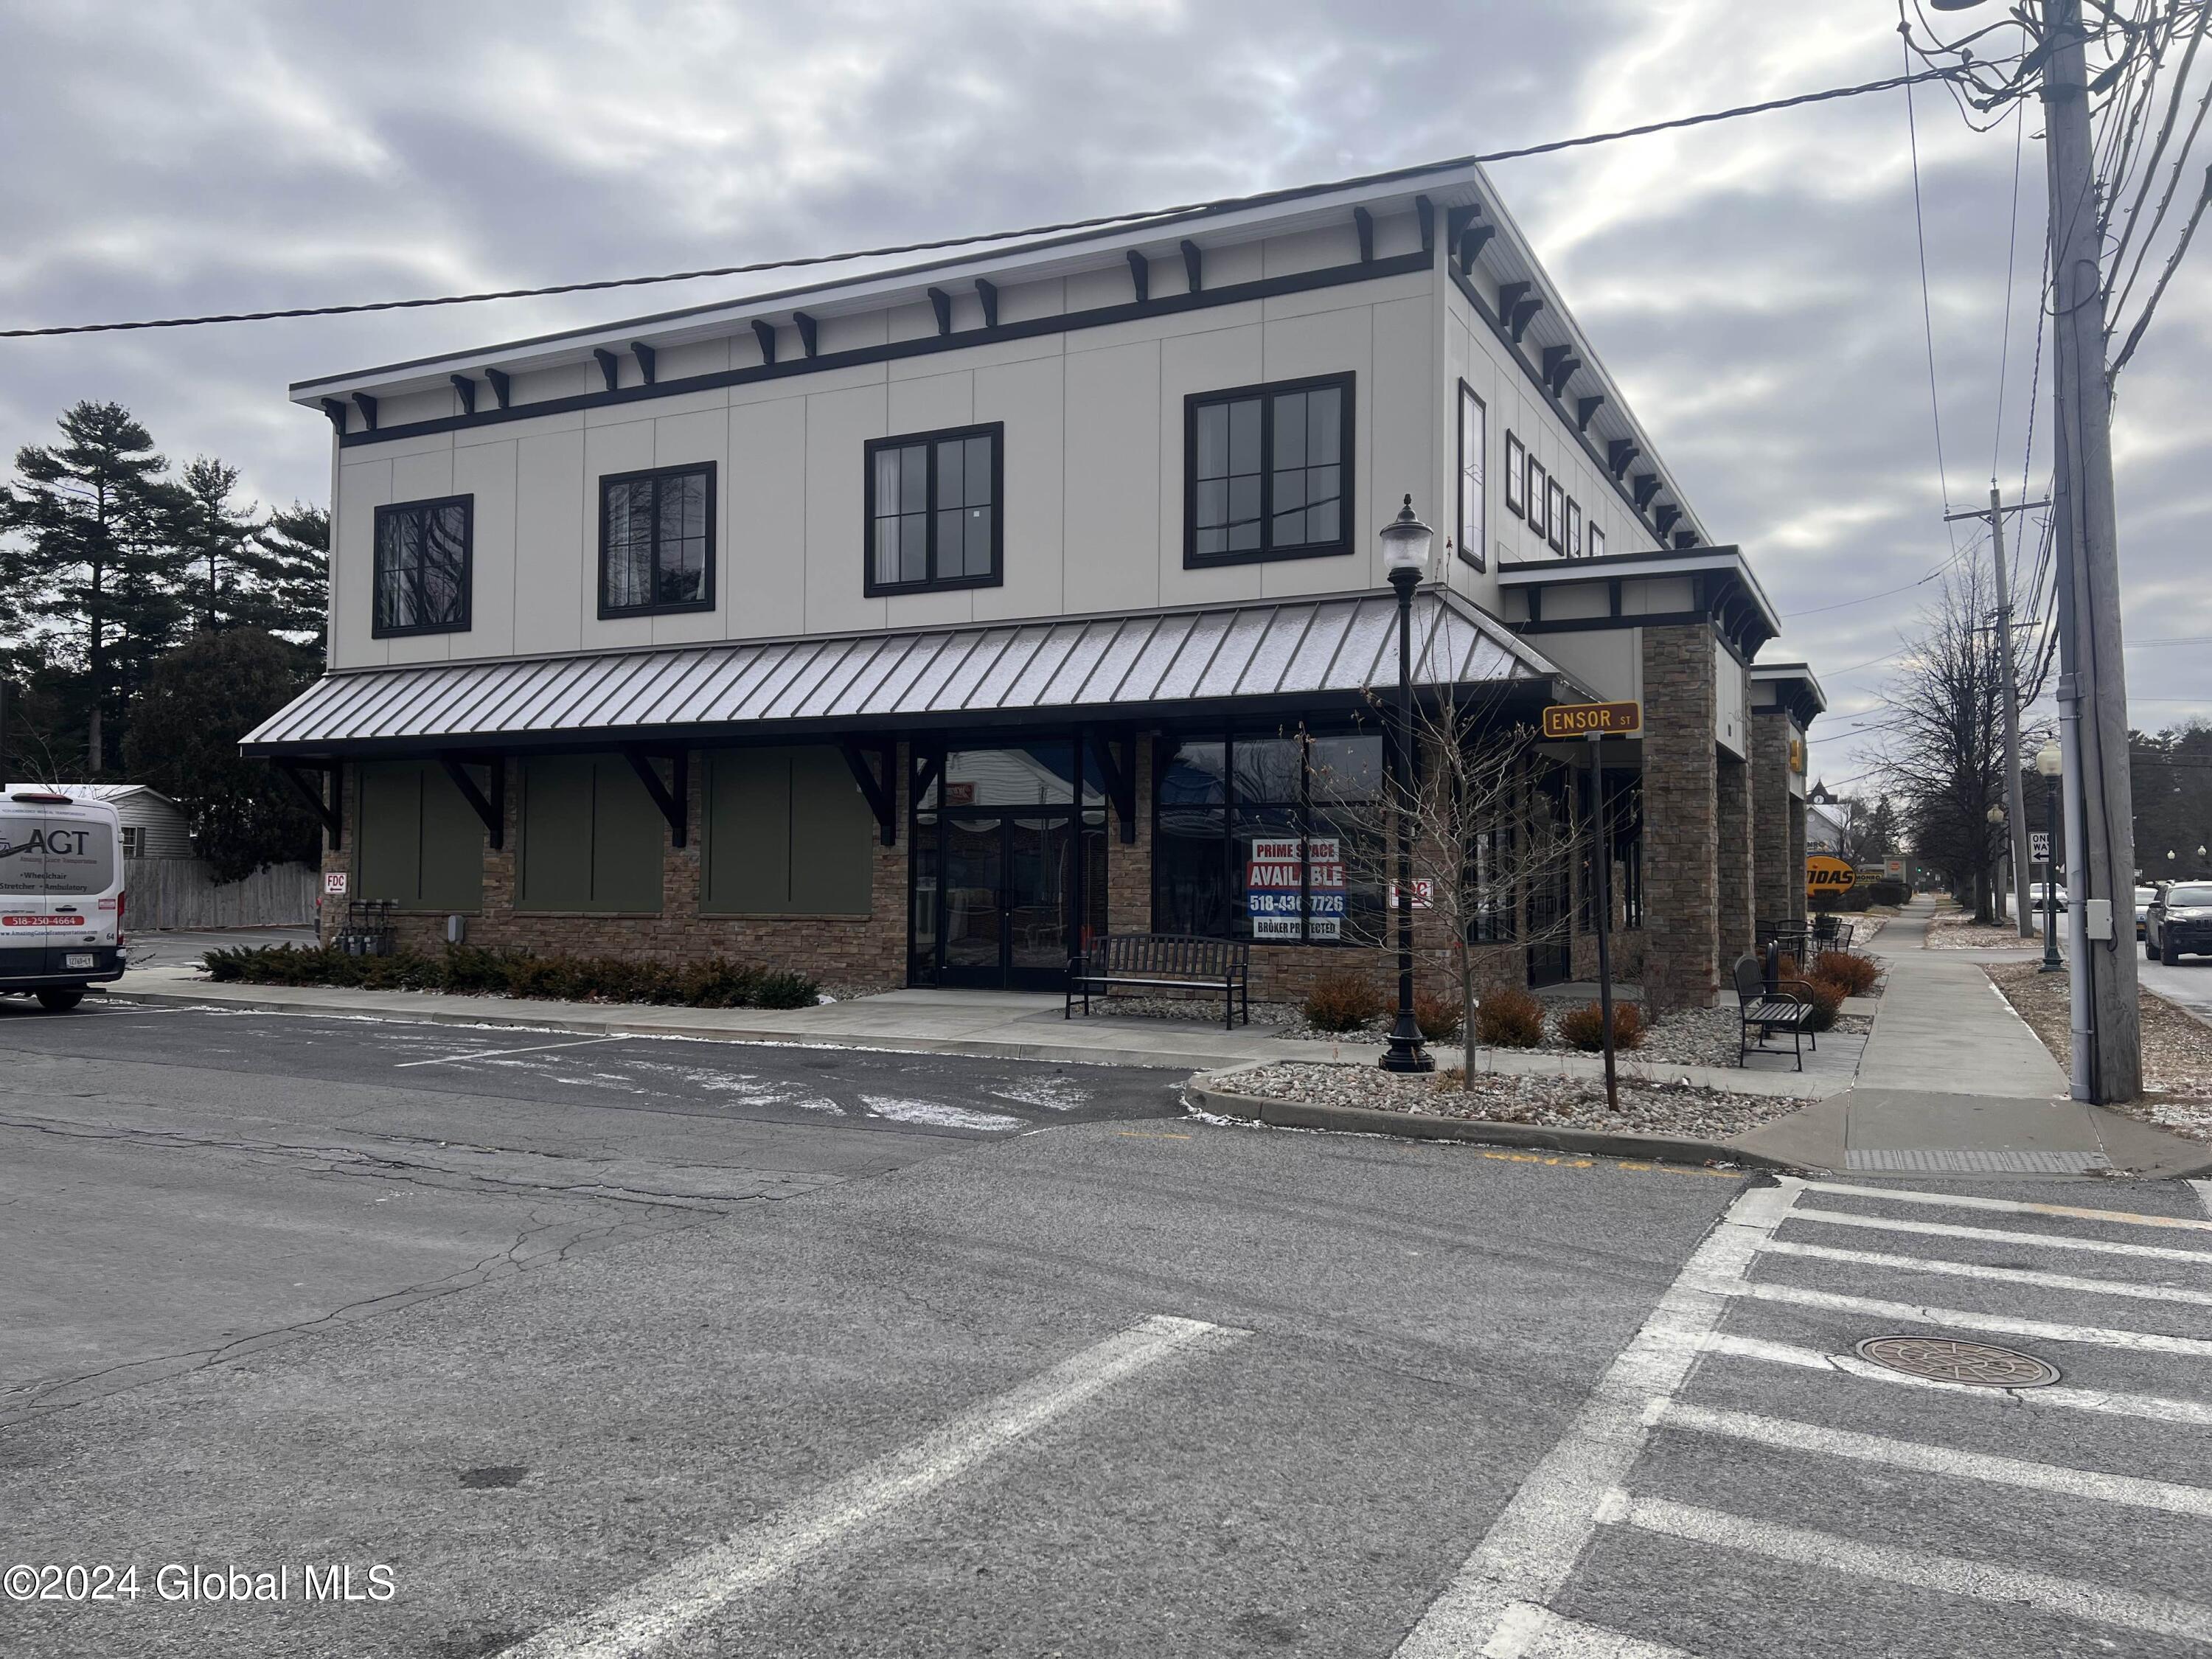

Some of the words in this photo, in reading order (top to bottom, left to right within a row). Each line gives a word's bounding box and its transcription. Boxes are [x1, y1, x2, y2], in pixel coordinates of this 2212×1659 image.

[1553, 710, 1611, 730] ENSOR
[1620, 716, 1631, 726] ST
[24, 829, 89, 855] AGT
[1257, 844, 1293, 857] PRIME
[1296, 844, 1335, 858] SACE
[328, 875, 344, 886] FDC
[1251, 866, 1343, 886] AVAILBLE
[1806, 870, 1854, 883] IDAS
[1250, 895, 1343, 911] 518-4307726
[1258, 922, 1288, 933] BROKER
[1290, 922, 1335, 934] PRECTED
